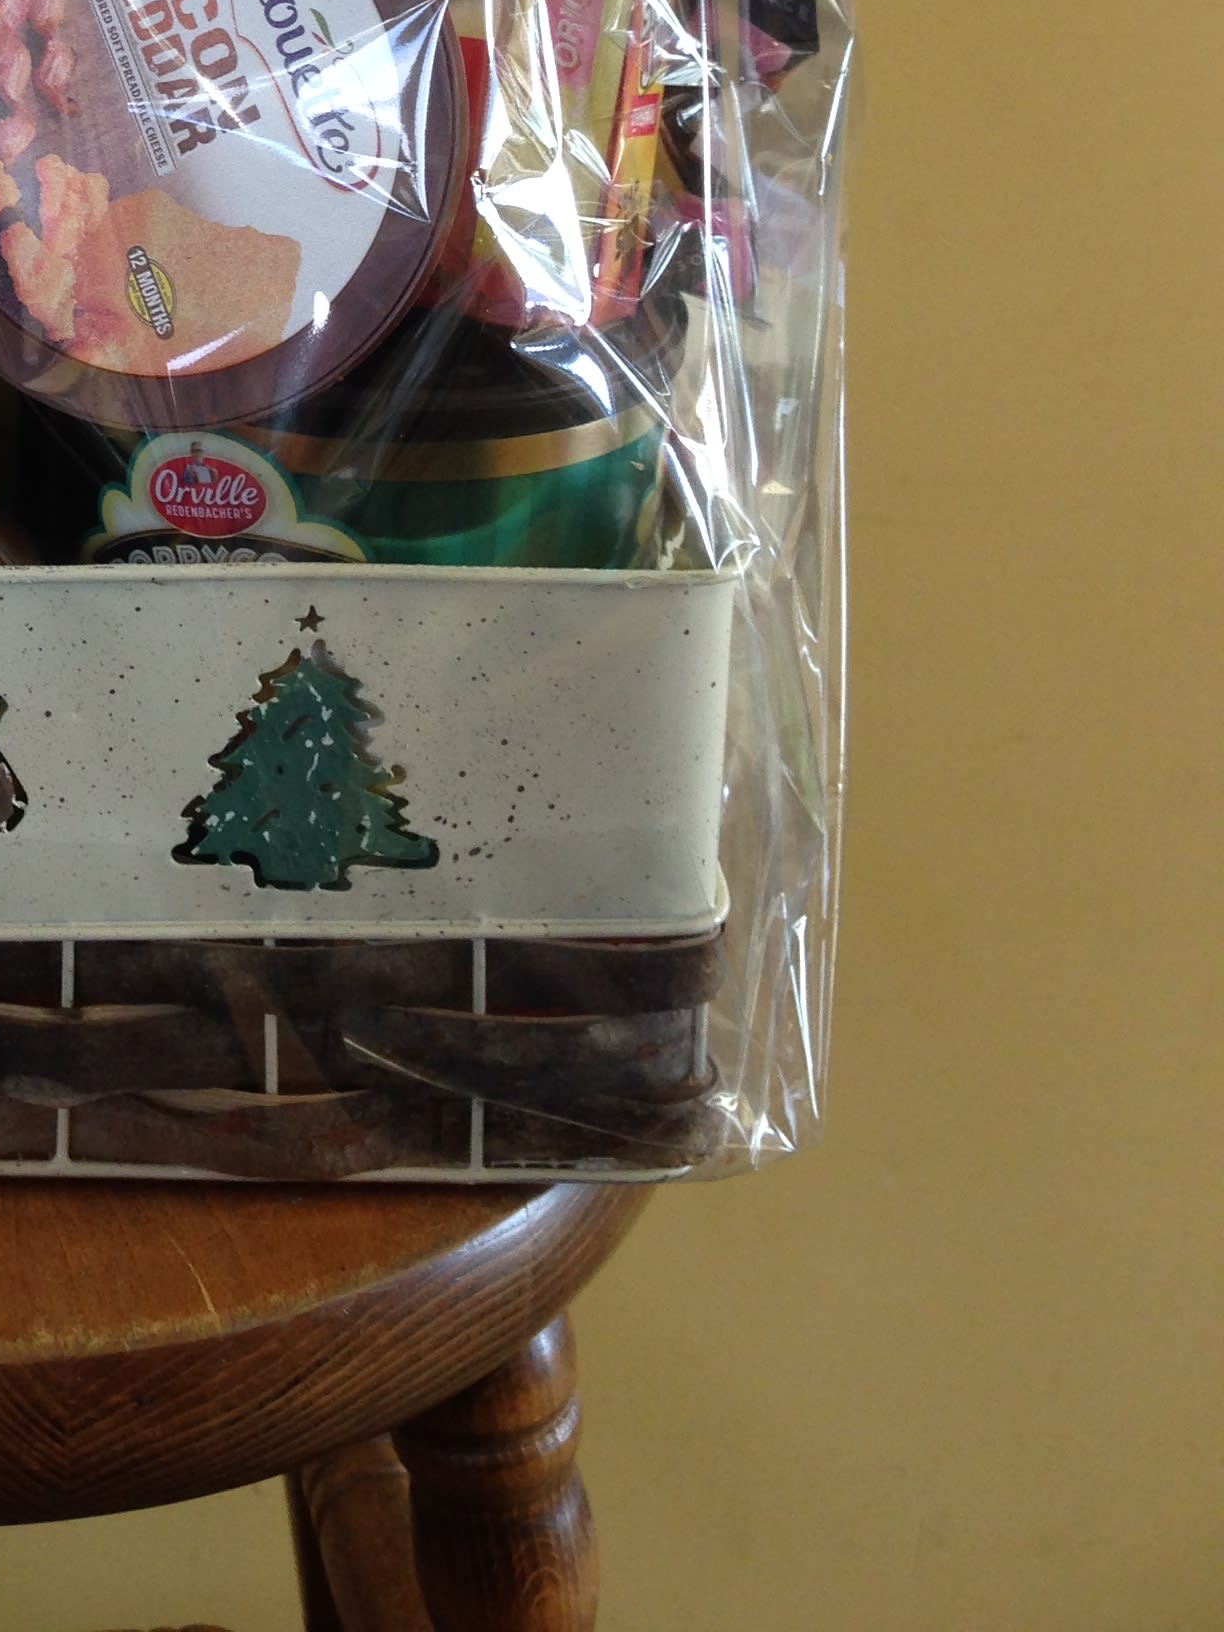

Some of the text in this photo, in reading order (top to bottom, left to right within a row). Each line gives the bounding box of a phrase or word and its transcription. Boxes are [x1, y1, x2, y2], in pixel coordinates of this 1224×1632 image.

[103, 23, 124, 53] SOFT
[145, 125, 168, 169] CHEESE
[129, 249, 147, 268] 12
[136, 271, 172, 335] MONTHS
[155, 469, 260, 506] Orville
[165, 504, 254, 520] REDENBACHER'S
